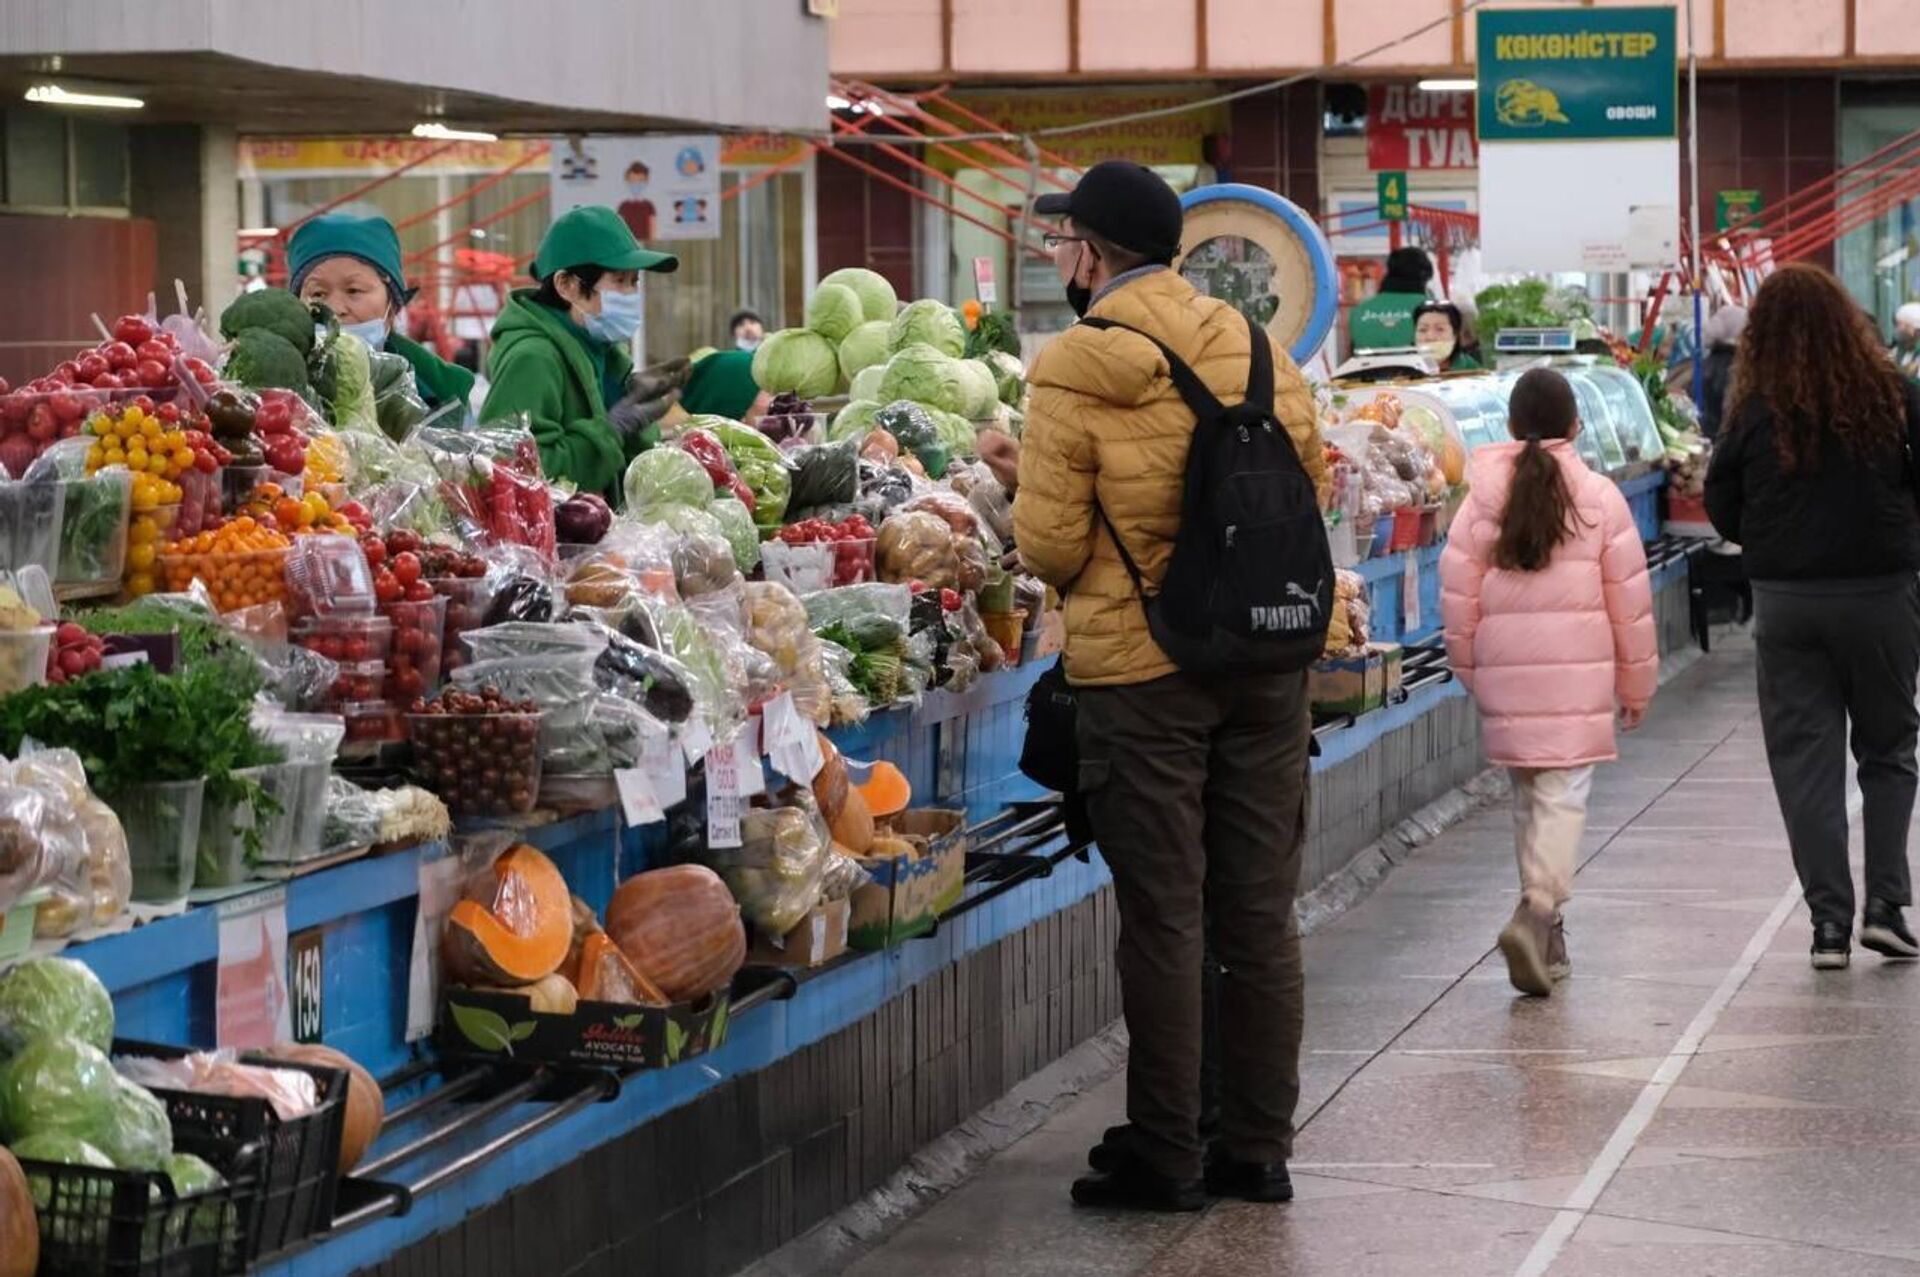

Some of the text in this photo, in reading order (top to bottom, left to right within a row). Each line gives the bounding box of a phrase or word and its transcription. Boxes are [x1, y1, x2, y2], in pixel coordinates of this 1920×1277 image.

[1403, 128, 1478, 167] ТУА
[1385, 178, 1398, 201] 4
[1251, 604, 1312, 631] PUMA
[296, 945, 321, 1041] 159
